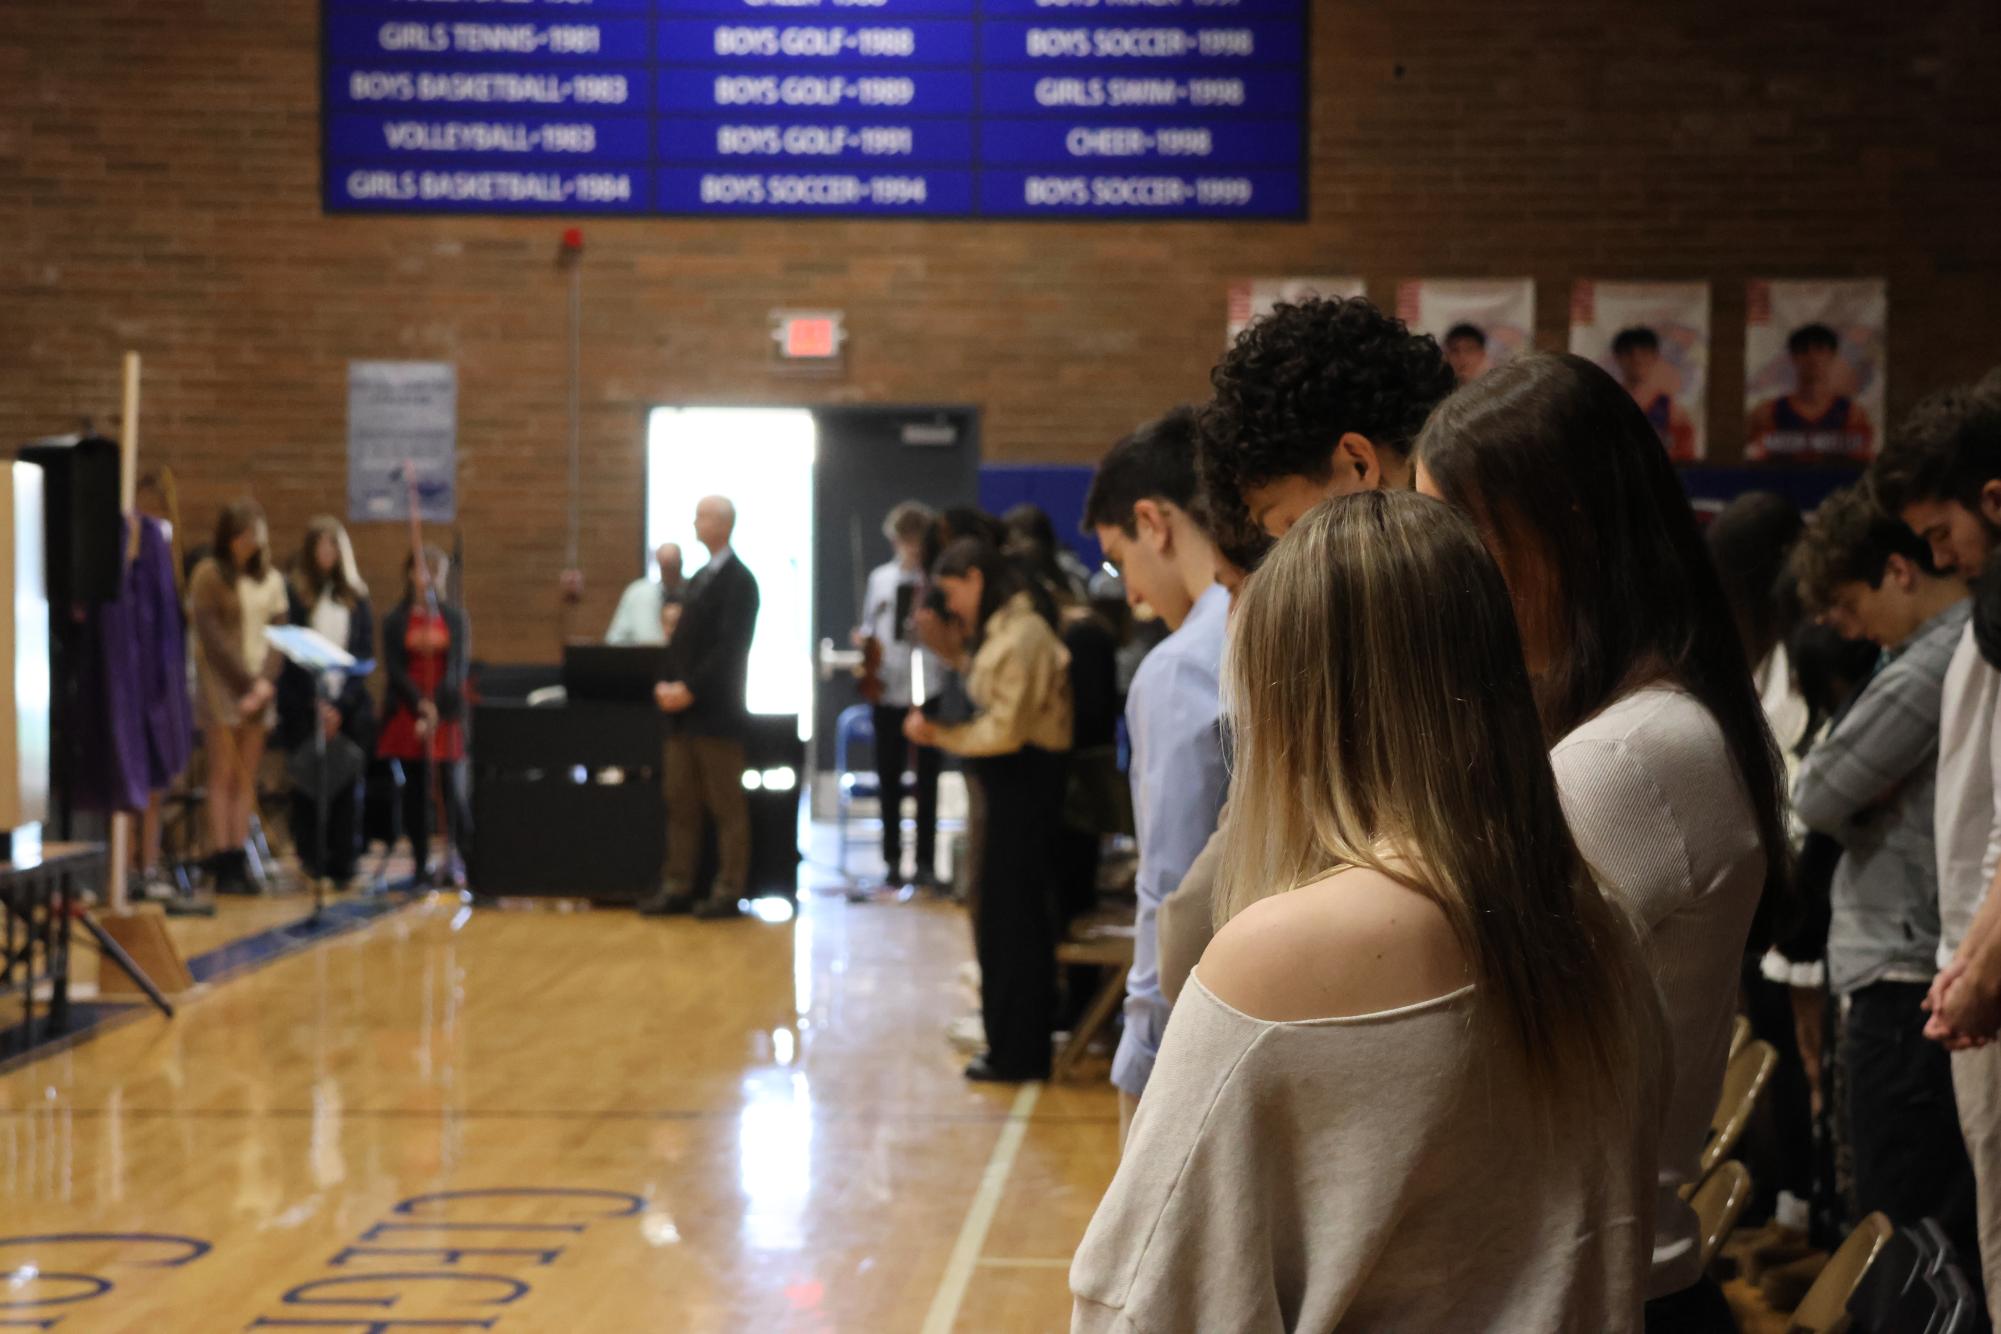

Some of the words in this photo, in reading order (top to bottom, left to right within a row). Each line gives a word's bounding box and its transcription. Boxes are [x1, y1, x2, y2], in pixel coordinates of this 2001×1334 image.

[378, 22, 449, 52] GIRLS
[714, 26, 779, 56] BOYS
[1026, 28, 1091, 57] BOYS
[350, 72, 415, 103] BOYS
[714, 75, 779, 105] BOYS
[1035, 77, 1105, 106] GIRLS
[717, 125, 781, 154] BOYS
[347, 170, 417, 201] GIRLS
[701, 175, 766, 204] BOYS
[1025, 176, 1090, 205] BOYS
